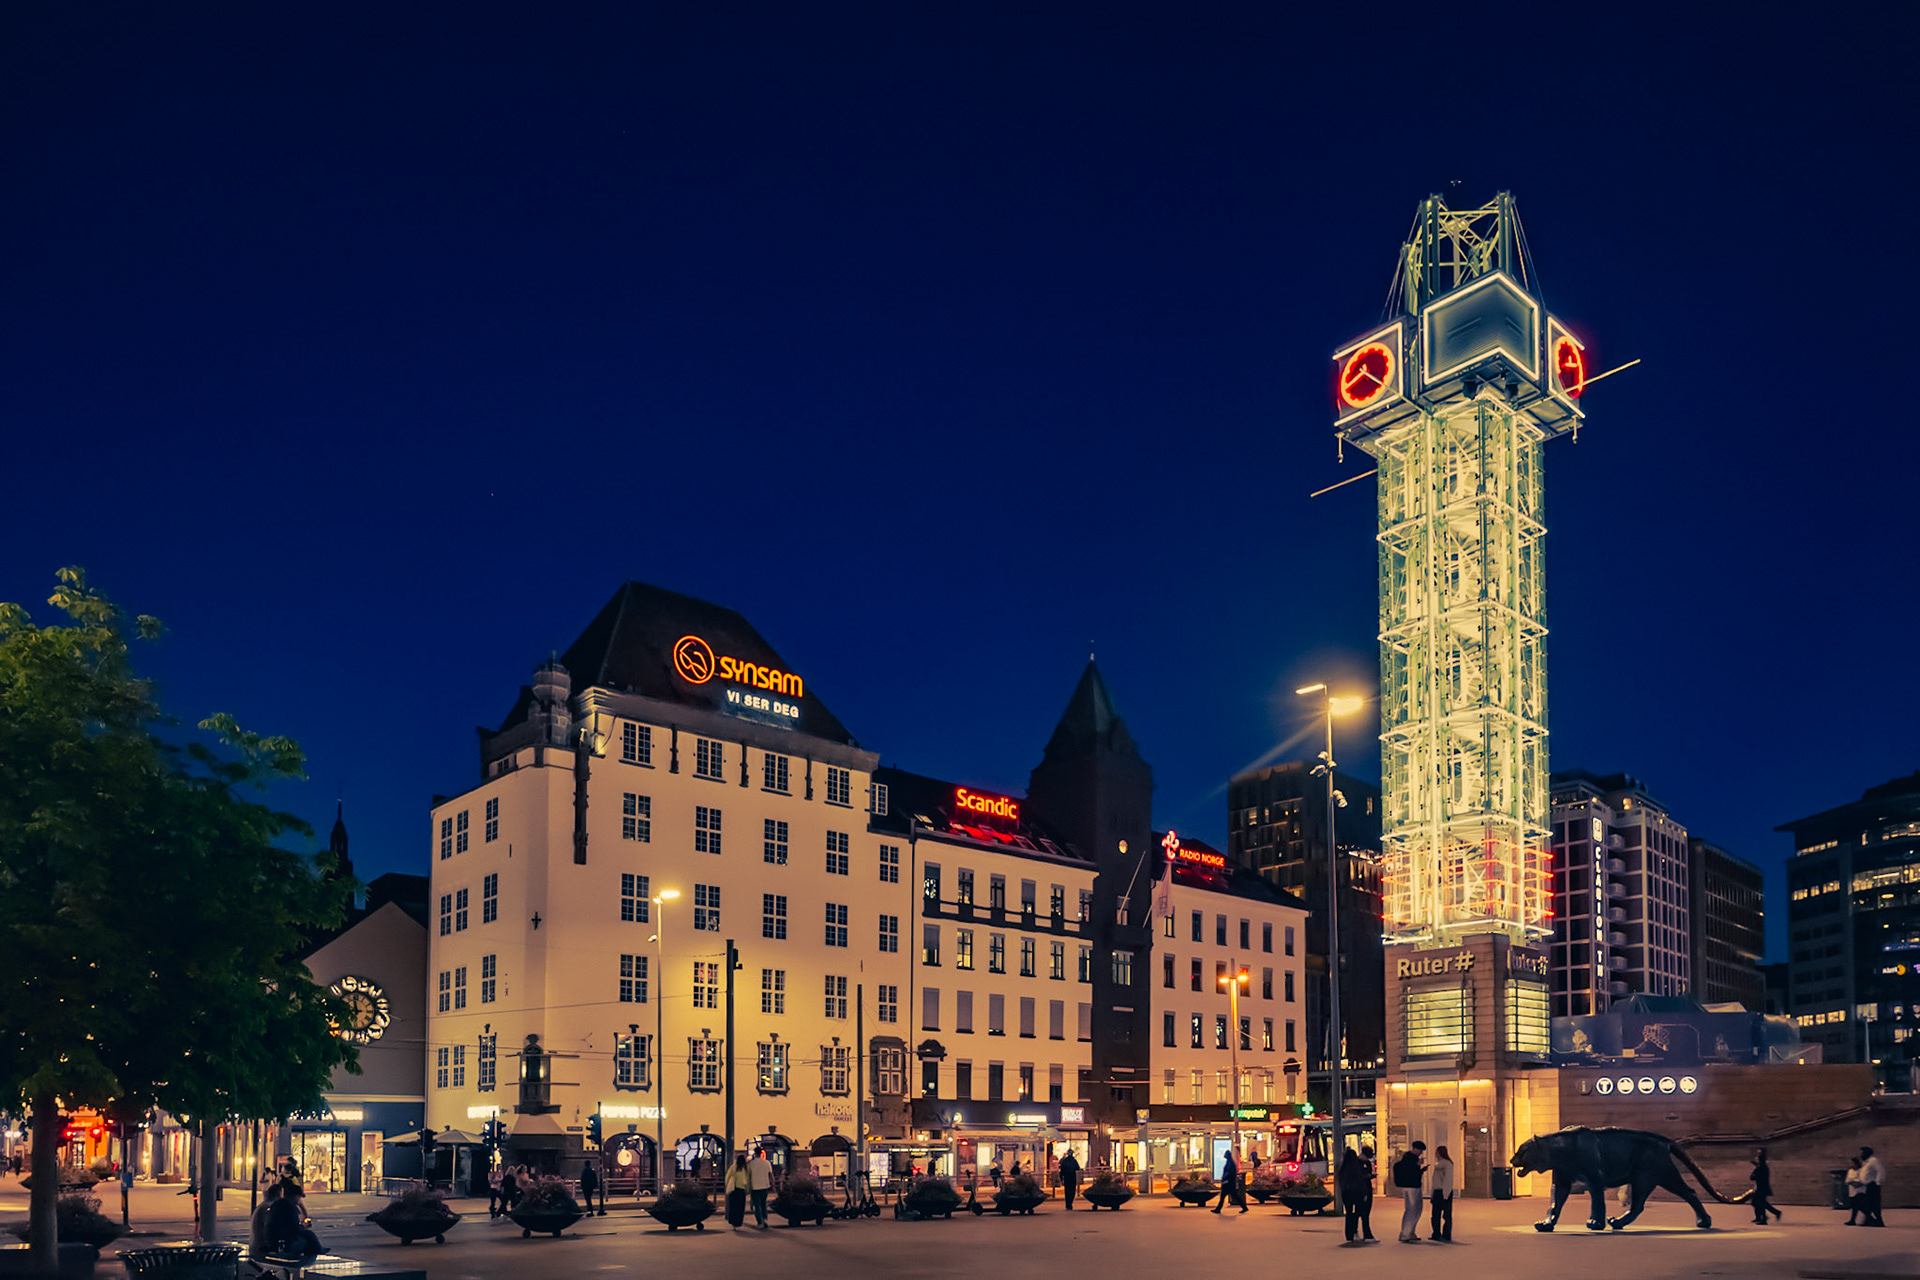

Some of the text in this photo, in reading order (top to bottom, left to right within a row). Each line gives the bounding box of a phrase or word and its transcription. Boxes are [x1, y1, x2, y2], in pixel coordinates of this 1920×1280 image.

[719, 656, 803, 698] SYNSAM
[726, 689, 800, 718] VI SER DEG
[956, 787, 1018, 820] Scandic
[1179, 848, 1225, 868] RADIO NORGE
[1397, 950, 1476, 978] Ruter#
